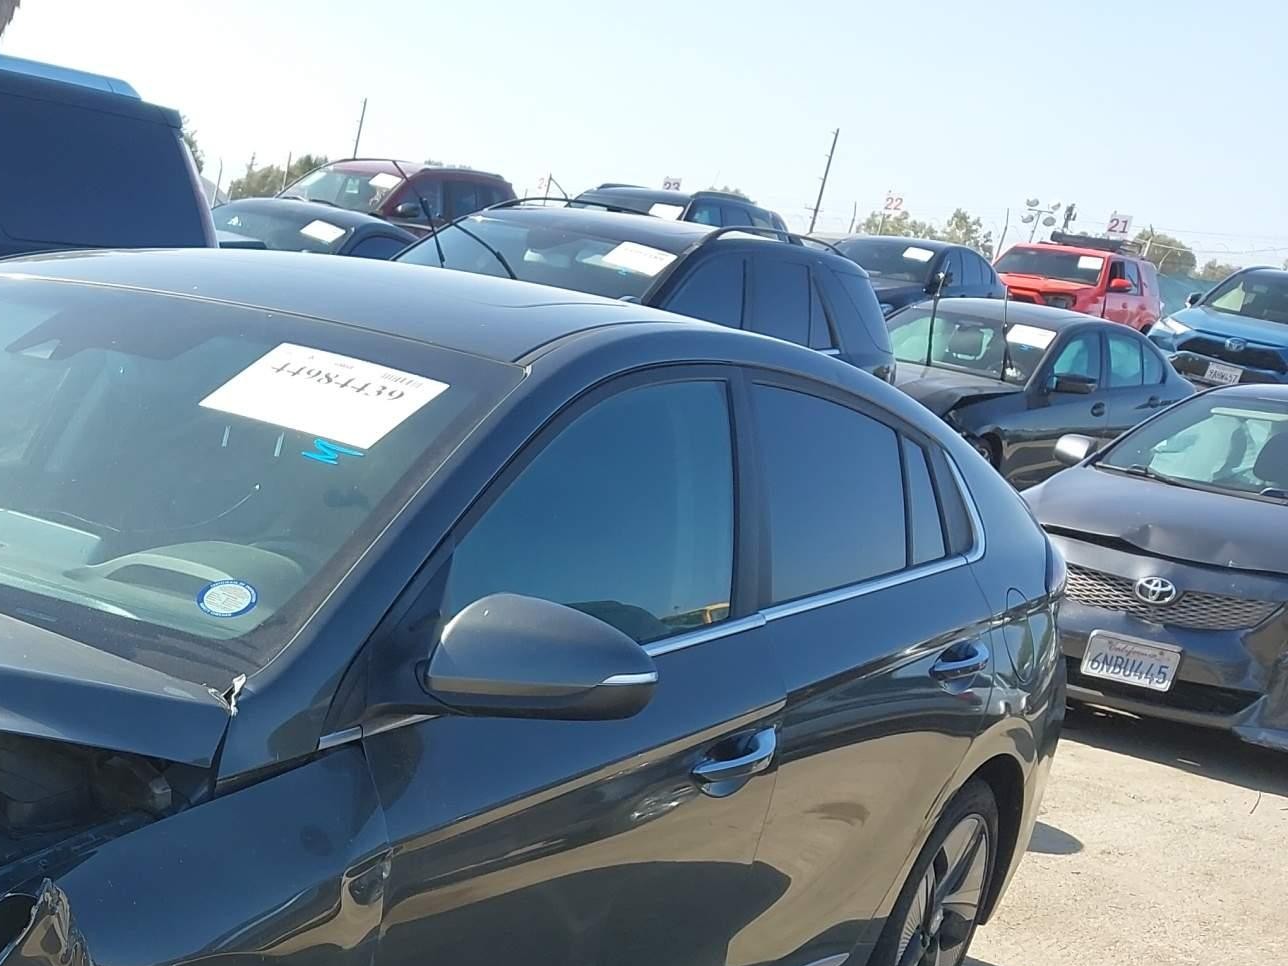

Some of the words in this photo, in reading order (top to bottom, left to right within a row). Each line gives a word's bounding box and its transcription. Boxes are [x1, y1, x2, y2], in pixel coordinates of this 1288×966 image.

[664, 181, 681, 191] 23
[884, 197, 903, 210] 22
[1108, 218, 1128, 233] 21
[270, 361, 405, 401] 44984439
[1108, 643, 1158, 659] California
[1089, 652, 1169, 685] 6NBU445
